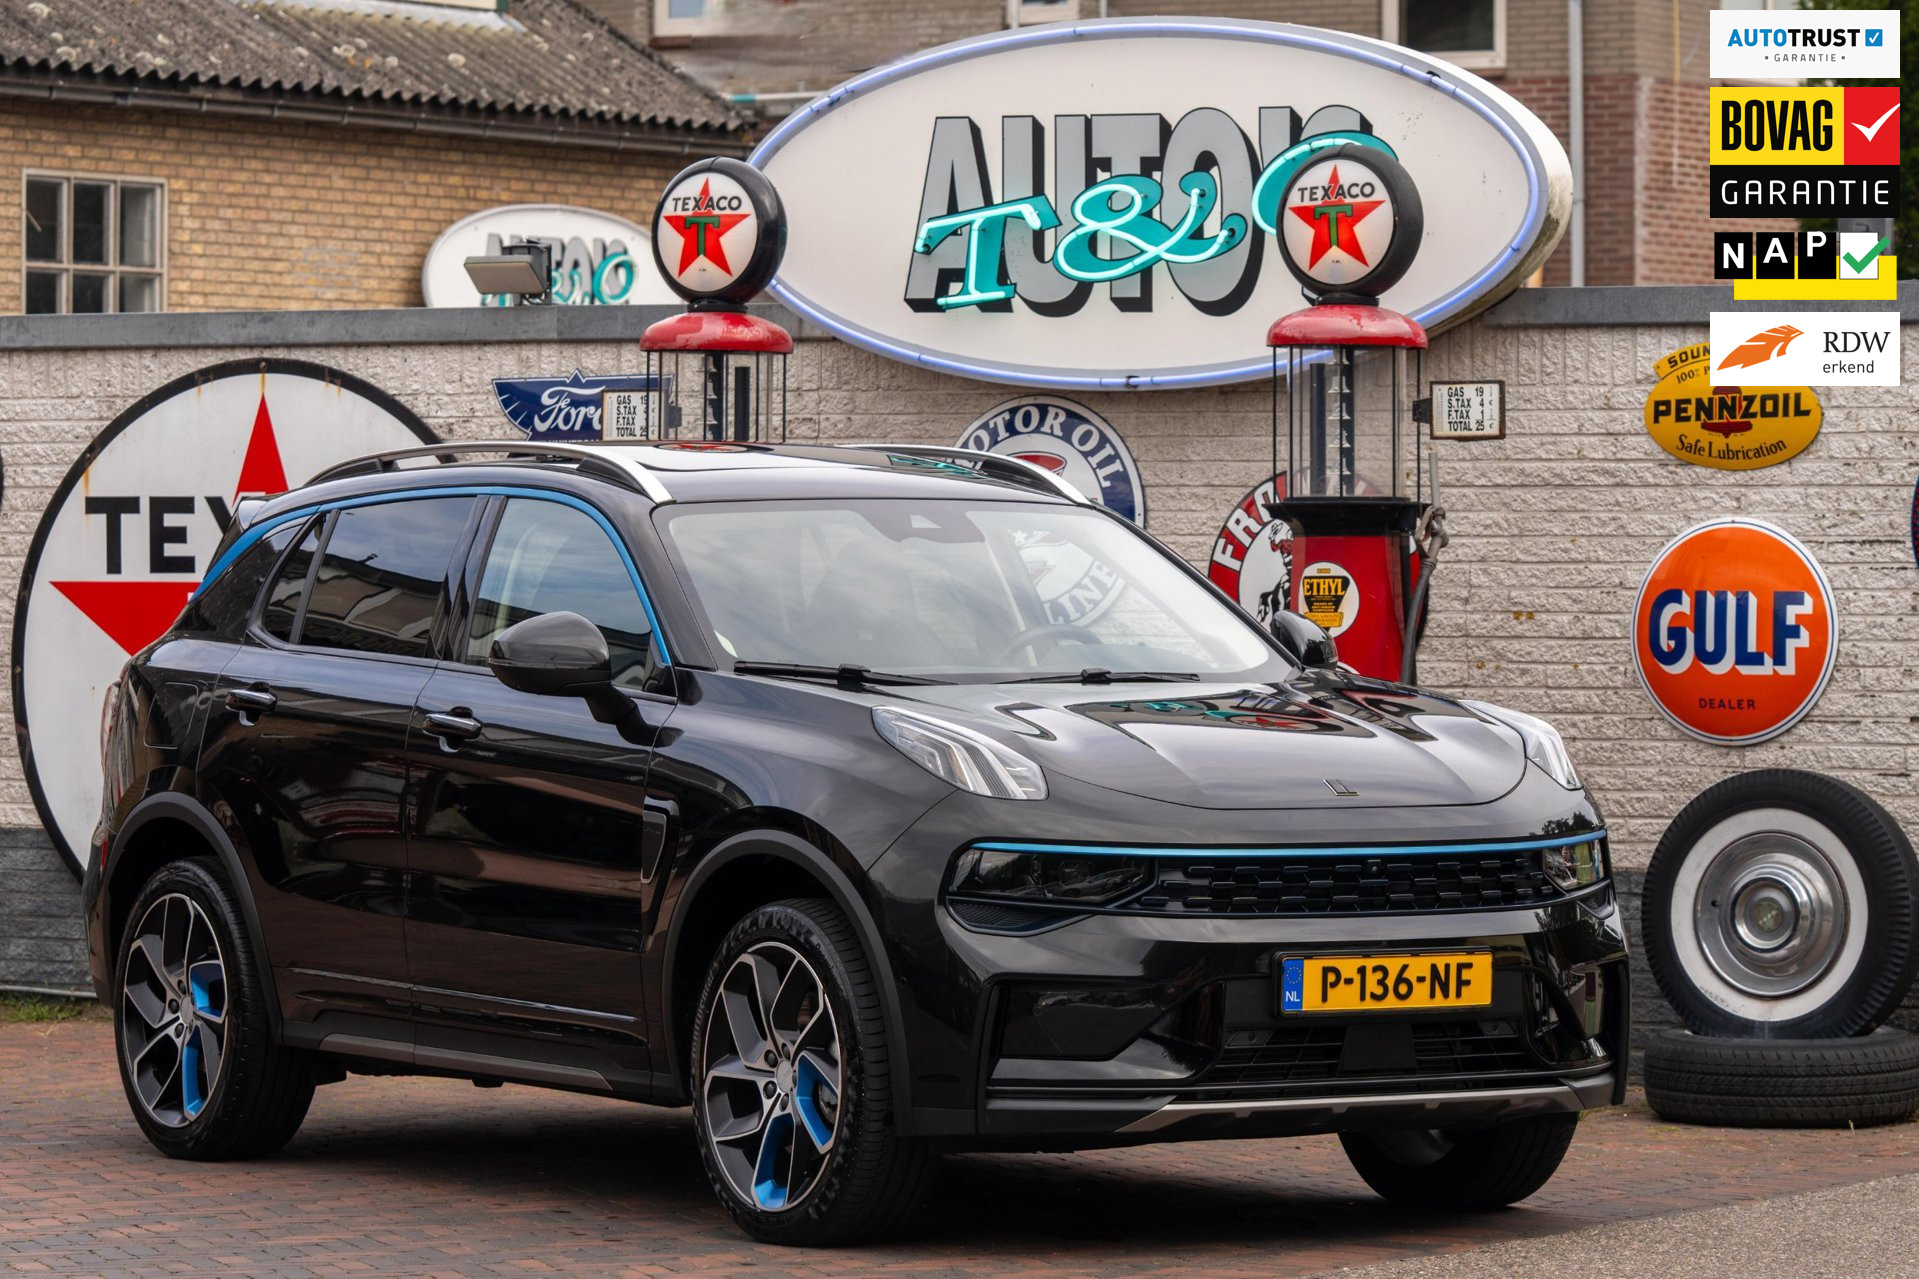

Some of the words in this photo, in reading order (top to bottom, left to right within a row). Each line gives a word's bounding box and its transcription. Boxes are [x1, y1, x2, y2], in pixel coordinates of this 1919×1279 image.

[1297, 182, 1376, 203] TEXACO
[672, 195, 743, 213] TEXACO
[1314, 204, 1353, 248] T
[684, 215, 720, 257] T
[616, 394, 632, 405] GAS
[1447, 386, 1465, 398] GAS
[1475, 386, 1485, 397] 19
[533, 386, 606, 432] For
[616, 405, 637, 416] S.TAX
[1447, 398, 1471, 409] S.TAX
[1479, 398, 1485, 409] 4
[1653, 393, 1812, 424] PENNZOIL
[616, 416, 636, 427] F.TAX
[1448, 409, 1471, 420] F.TAX
[1480, 409, 1485, 420] 1
[616, 427, 637, 438] TOTAL
[1448, 420, 1473, 432] TOTAL
[1475, 420, 1485, 432] 25
[1071, 423, 1124, 488] OIL
[1676, 434, 1705, 457] Safe
[1708, 440, 1787, 461] Lubrication
[1303, 578, 1346, 596] ETHYL
[1648, 588, 1814, 676] GULF
[1698, 698, 1757, 710] DEALER
[1285, 991, 1301, 1002] NL
[1321, 961, 1474, 1003] P-136-NF
